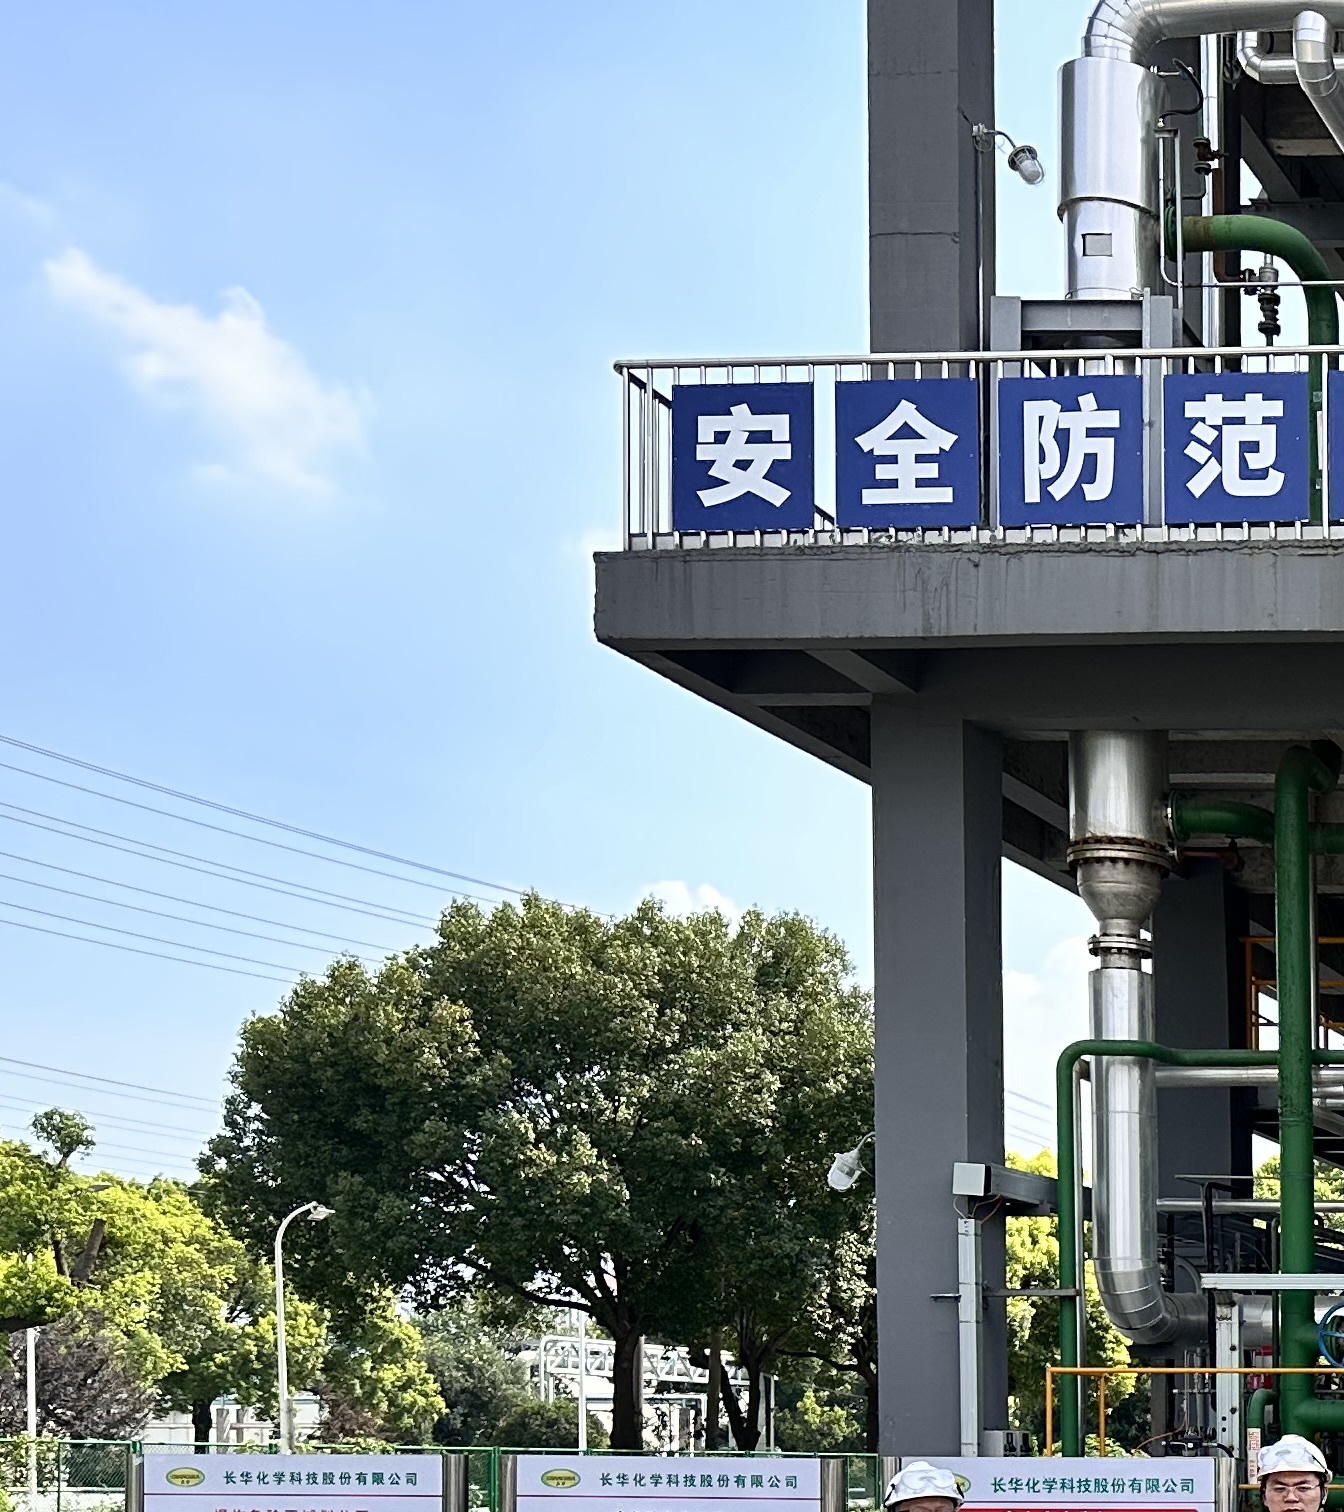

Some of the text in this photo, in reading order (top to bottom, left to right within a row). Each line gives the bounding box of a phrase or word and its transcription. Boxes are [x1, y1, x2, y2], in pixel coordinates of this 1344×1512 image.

[223, 1471, 418, 1487] 长华化学科技股份有限公司
[599, 1472, 798, 1489] 长华化学科技股份有限公司
[990, 1476, 1195, 1494] 长华化学科技股份有限公司
